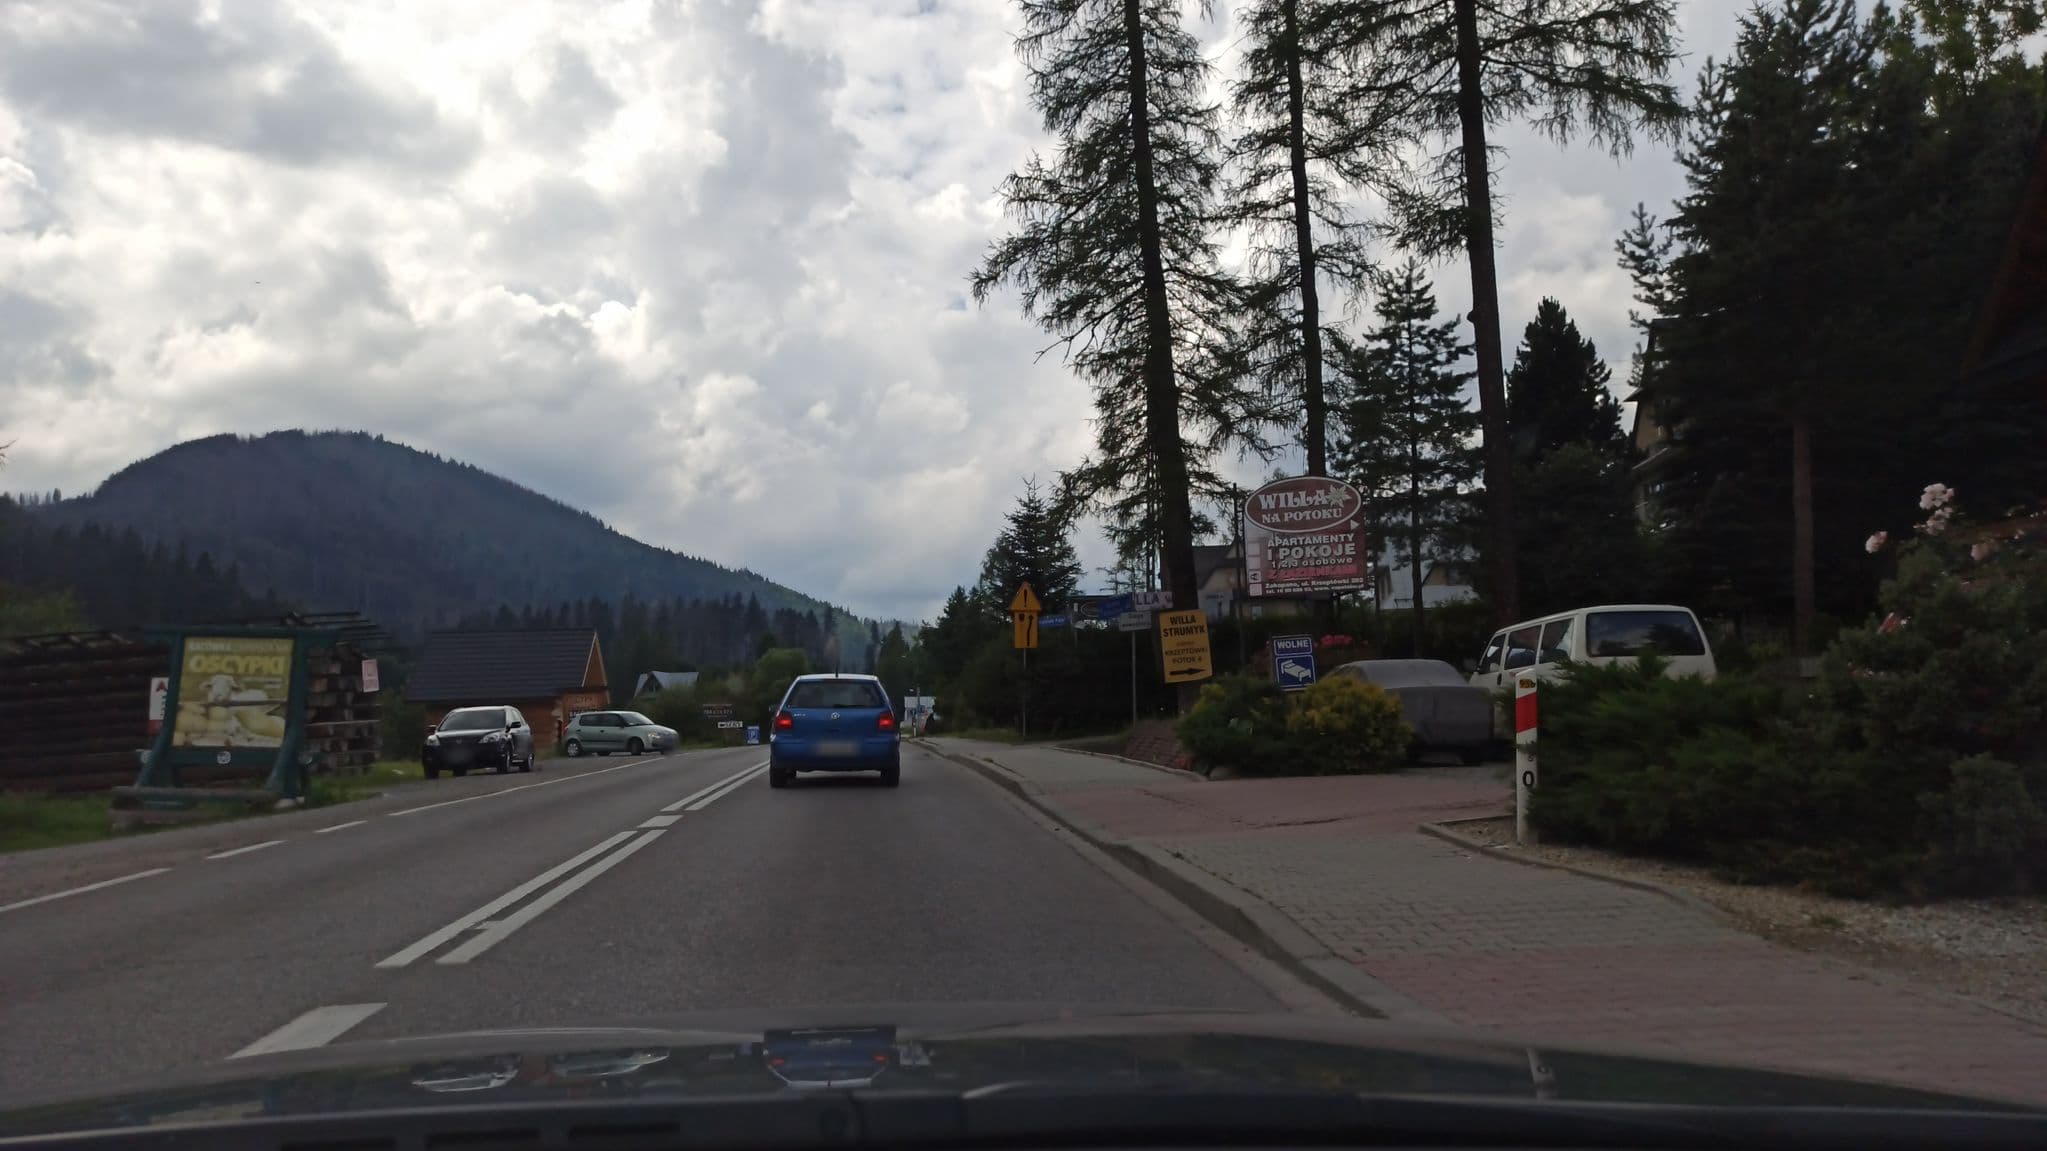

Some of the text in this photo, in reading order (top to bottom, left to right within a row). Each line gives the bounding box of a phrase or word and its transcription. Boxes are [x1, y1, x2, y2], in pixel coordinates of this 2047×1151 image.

[1258, 489, 1328, 510] WILLA
[1262, 508, 1343, 523] NA POTOKU
[1267, 533, 1355, 547] APARTAMENTY
[1279, 543, 1356, 559] POKOJE
[1272, 557, 1353, 569] 1,2,3 osobowe
[1169, 615, 1196, 625] WILLA
[1162, 625, 1205, 638] STRUMYK
[1277, 639, 1309, 649] WOLNE
